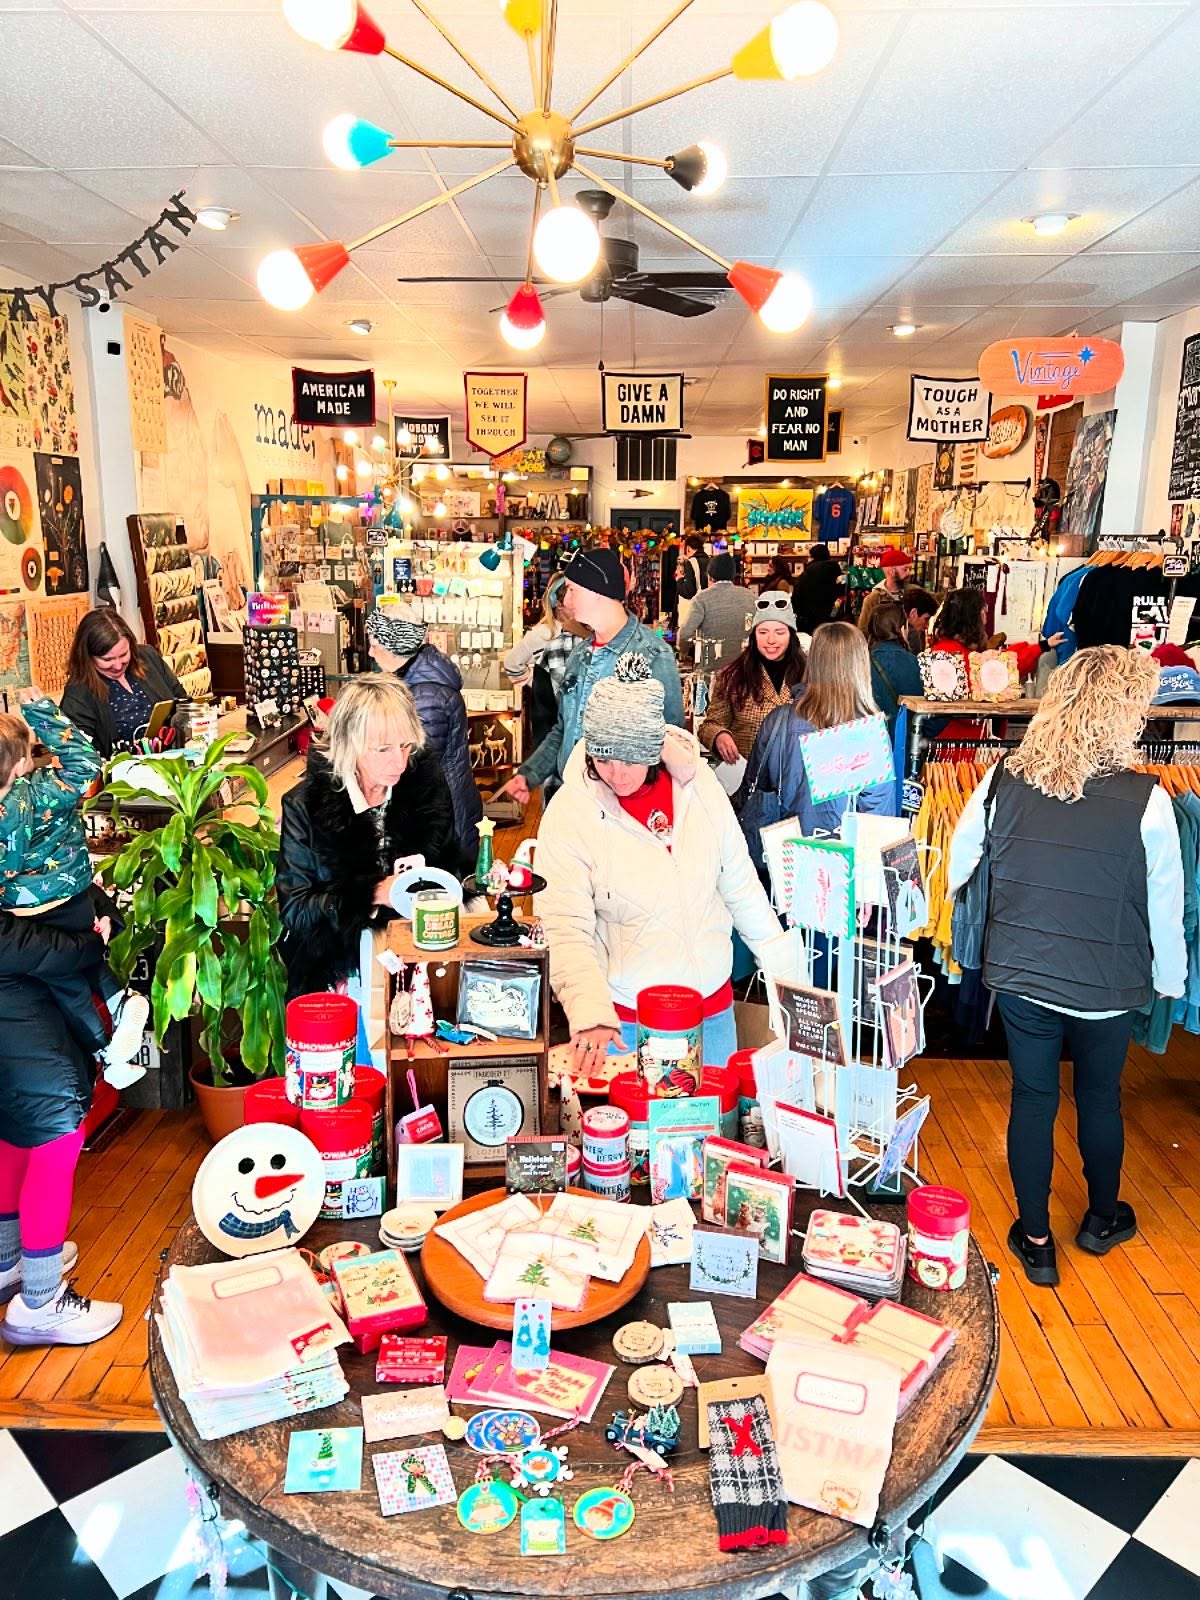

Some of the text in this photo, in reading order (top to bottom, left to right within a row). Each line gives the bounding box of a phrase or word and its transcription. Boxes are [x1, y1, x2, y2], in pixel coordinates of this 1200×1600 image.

[73, 189, 198, 308] SATAN
[1010, 350, 1082, 390] Vintage
[301, 382, 366, 398] AMERICAN
[471, 387, 518, 396] TOGETHER
[617, 383, 669, 402] GIVE A
[772, 388, 822, 401] DO RIGHT
[922, 386, 978, 403] TOUGH
[316, 400, 352, 415] MADE
[474, 401, 516, 409] WE WILL
[784, 406, 809, 418] AND
[935, 405, 962, 417] AS A
[480, 414, 510, 423] SEE IT
[620, 404, 666, 424] DAMN
[475, 428, 516, 437] THROUGH
[771, 422, 804, 435] FEAR
[805, 422, 821, 434] NO
[916, 416, 984, 435] MOTHER
[783, 439, 808, 452] MAN
[831, 503, 841, 518] 6
